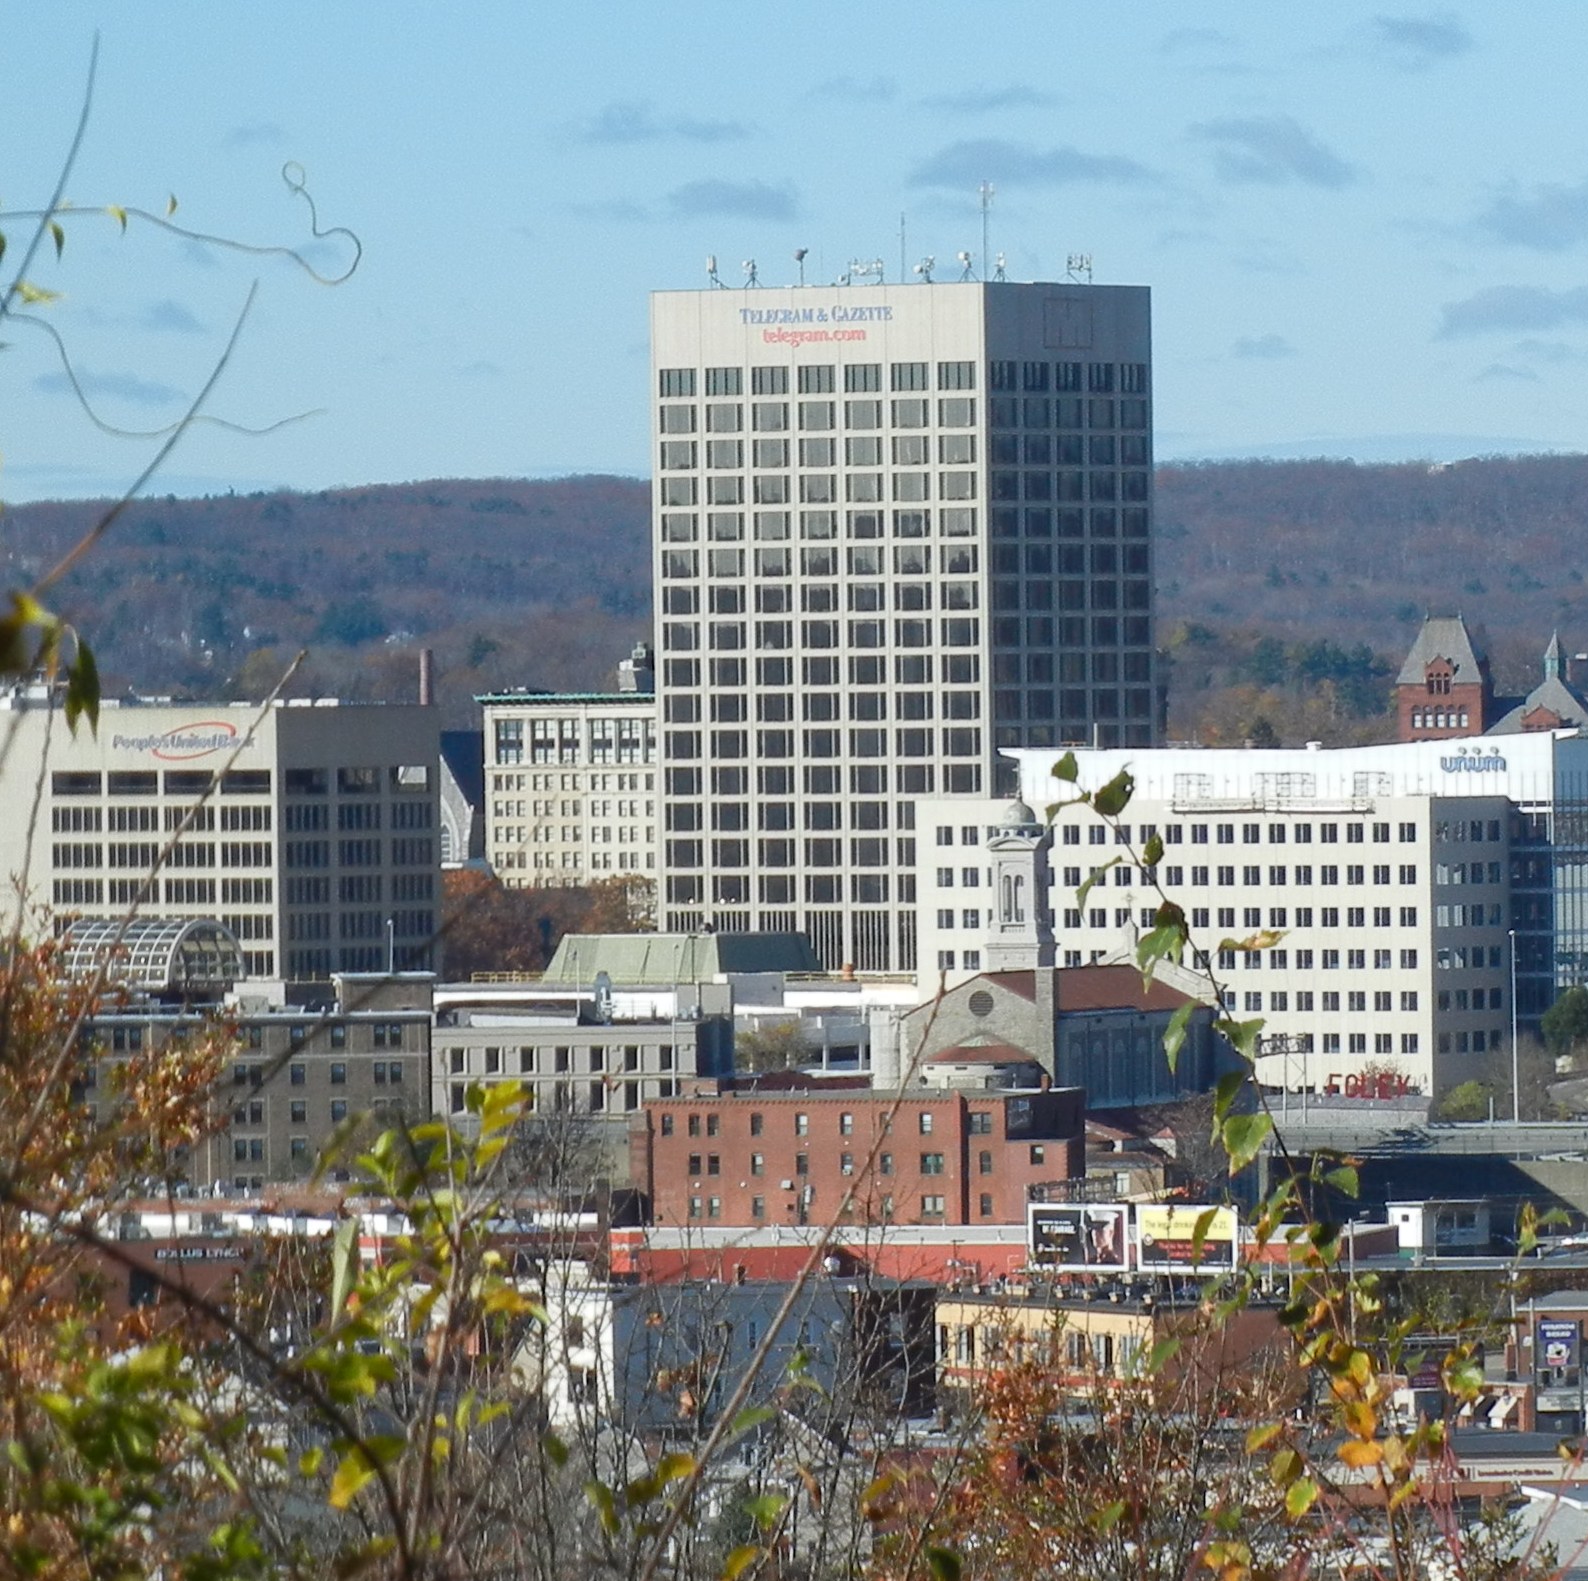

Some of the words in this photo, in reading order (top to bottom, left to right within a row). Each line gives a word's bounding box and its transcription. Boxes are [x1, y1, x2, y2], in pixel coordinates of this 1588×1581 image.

[739, 307, 814, 324] TELEGRAM
[817, 308, 828, 323] &
[831, 305, 893, 322] GAZETTE
[763, 326, 867, 347] telegram.com
[1440, 750, 1507, 773] unum
[1326, 1073, 1411, 1100] FOLEY
